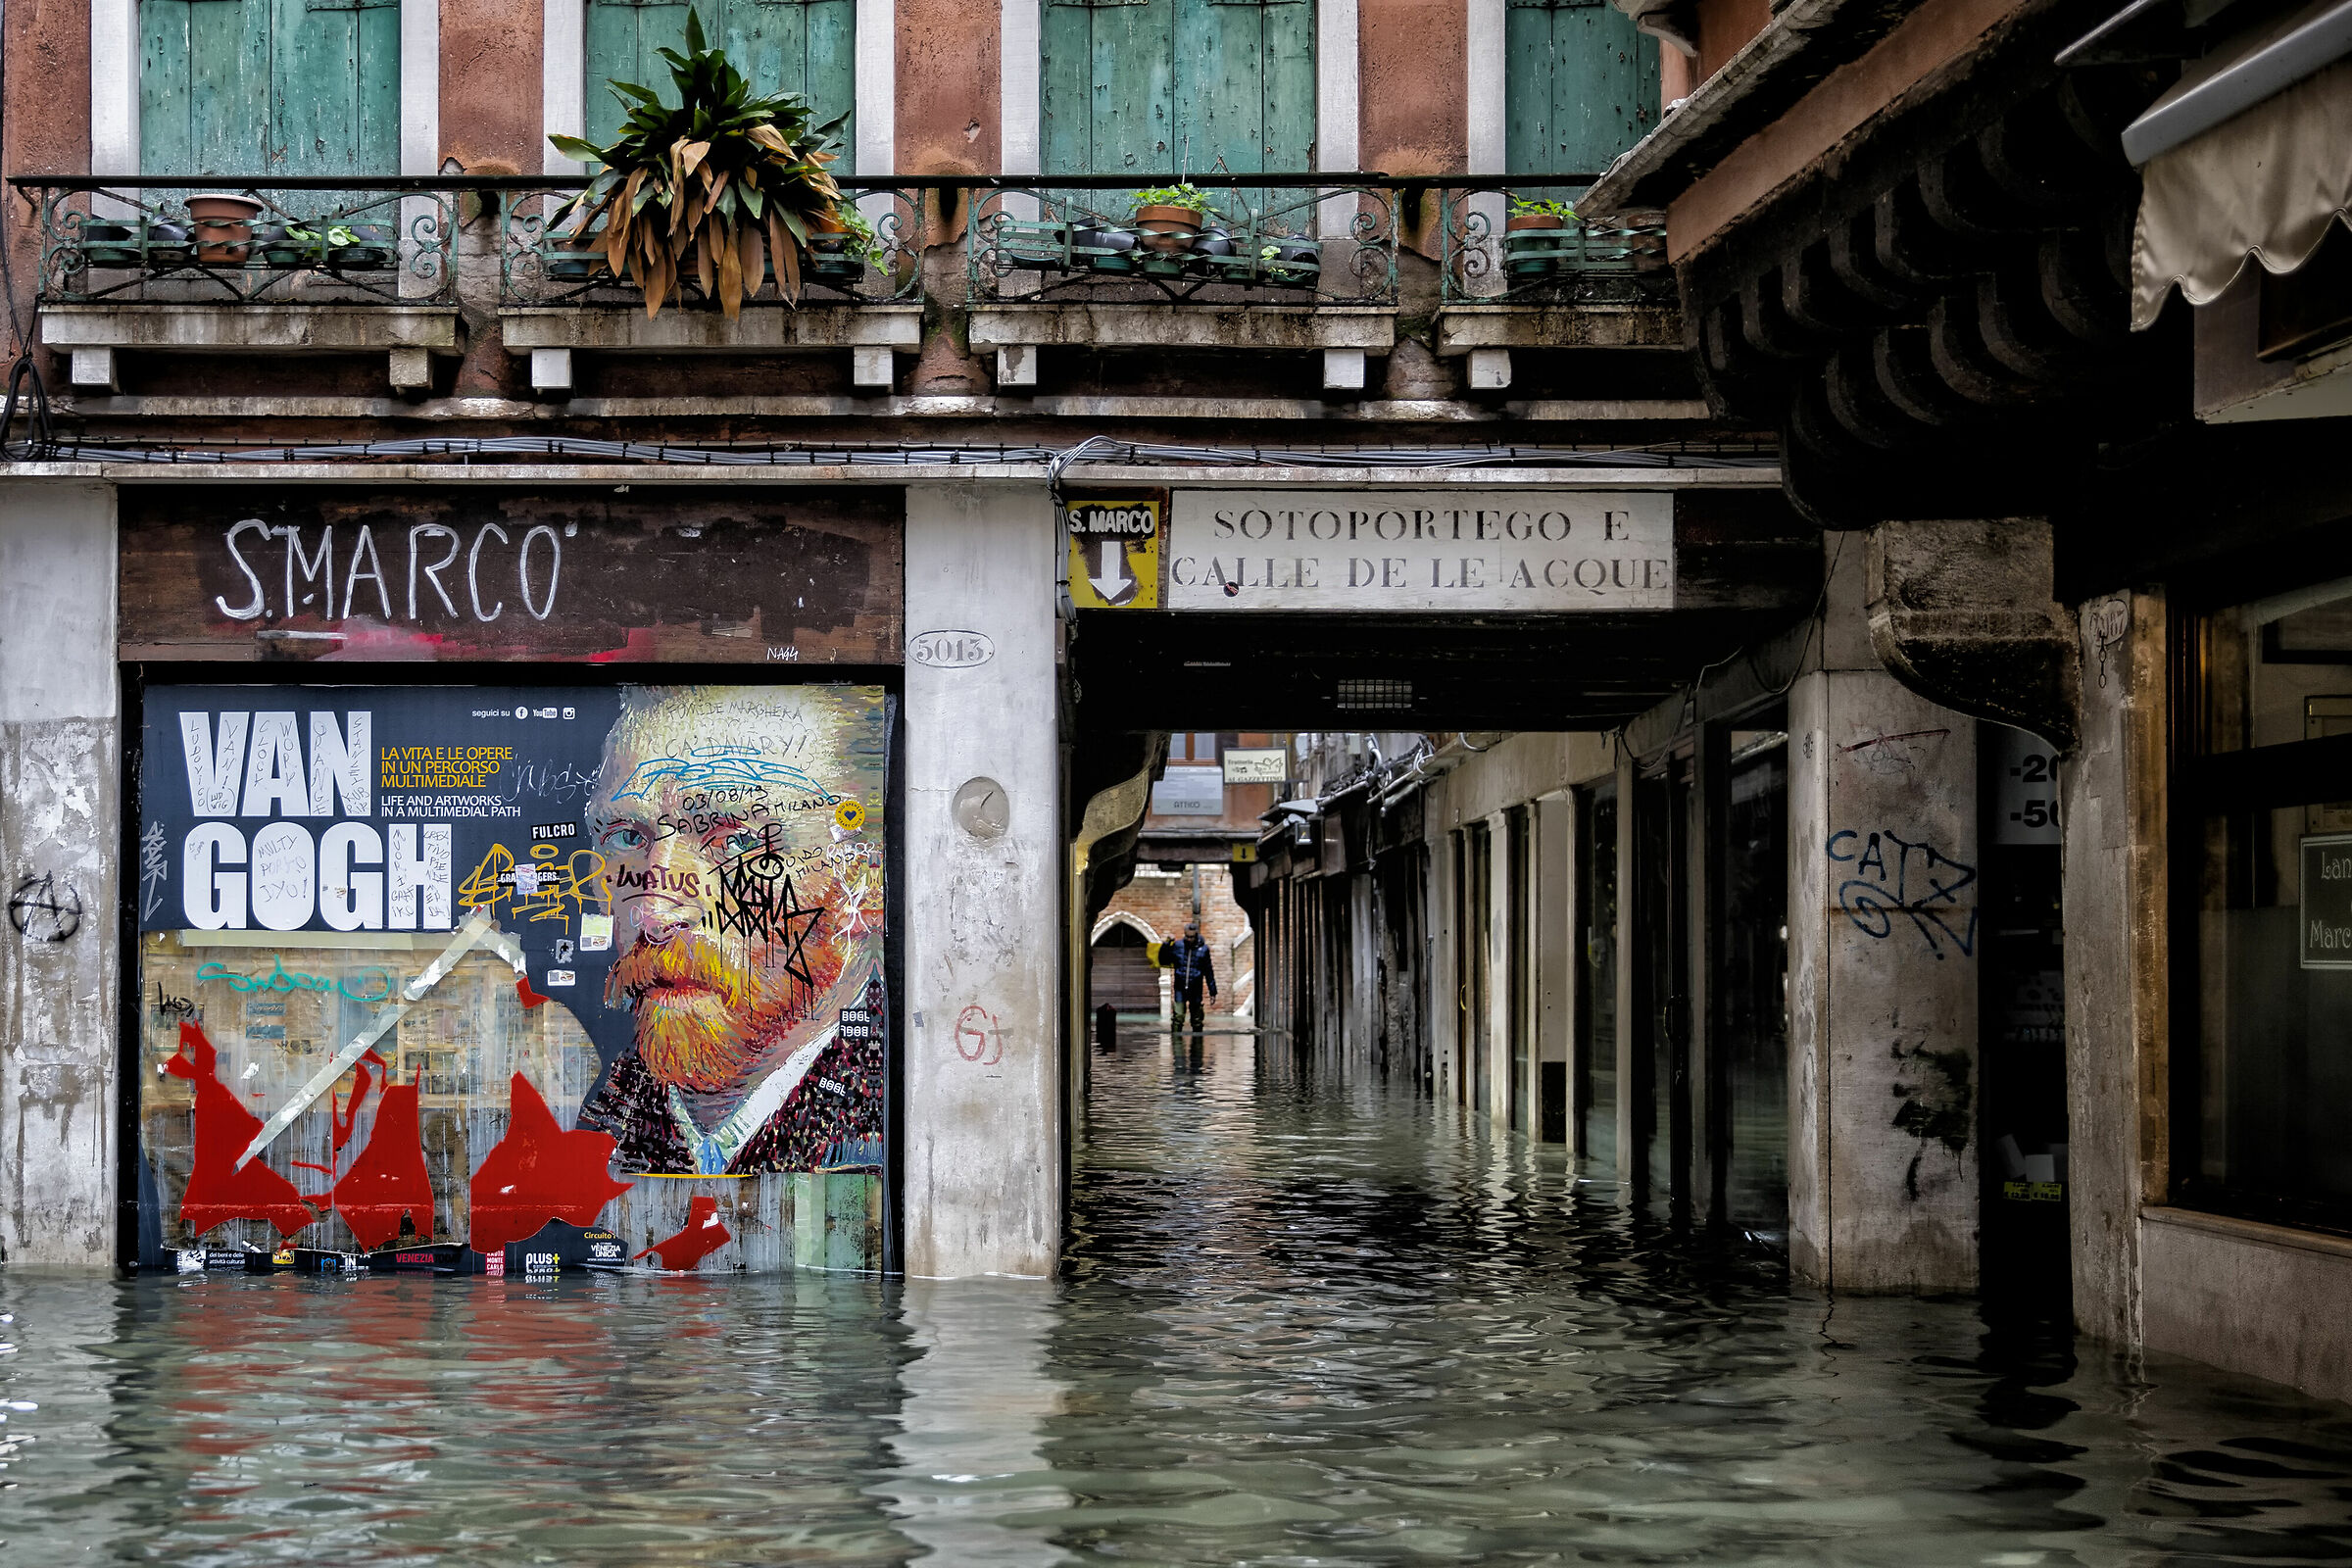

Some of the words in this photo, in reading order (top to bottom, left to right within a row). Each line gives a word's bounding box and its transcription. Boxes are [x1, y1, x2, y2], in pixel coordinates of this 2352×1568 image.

[1089, 510, 1154, 533] MARCO
[1213, 509, 1572, 542] SOTOPORTEGO
[1604, 510, 1630, 541] E
[1171, 556, 1319, 589] CALLE
[1349, 557, 1407, 588] DE
[1432, 557, 1486, 588] LE
[1509, 557, 1668, 596] ACQUE
[915, 638, 984, 662] 5013
[471, 709, 500, 718] seguici
[381, 747, 400, 760] LA
[402, 747, 433, 760] VITA
[436, 747, 444, 760] E
[448, 747, 464, 760] LE
[466, 747, 513, 760] OPERE
[179, 711, 371, 817] VAN
[381, 761, 396, 773] IN
[400, 761, 421, 773] UN
[425, 760, 501, 774] PERCORSO
[381, 775, 487, 787] MULTIMEDIALE
[381, 796, 404, 806] LIFE
[406, 796, 432, 806] AND
[435, 796, 501, 806] ARTWORKS
[381, 807, 393, 816] IN
[396, 807, 406, 816] A
[408, 807, 488, 816] MULTIMEDIAL
[492, 807, 520, 816] PATH
[654, 804, 771, 841] SABRINA
[770, 795, 842, 816] MILANO
[532, 824, 575, 839] FULCRO
[183, 821, 452, 931] GOGH
[396, 1253, 433, 1262] VENEZIA
